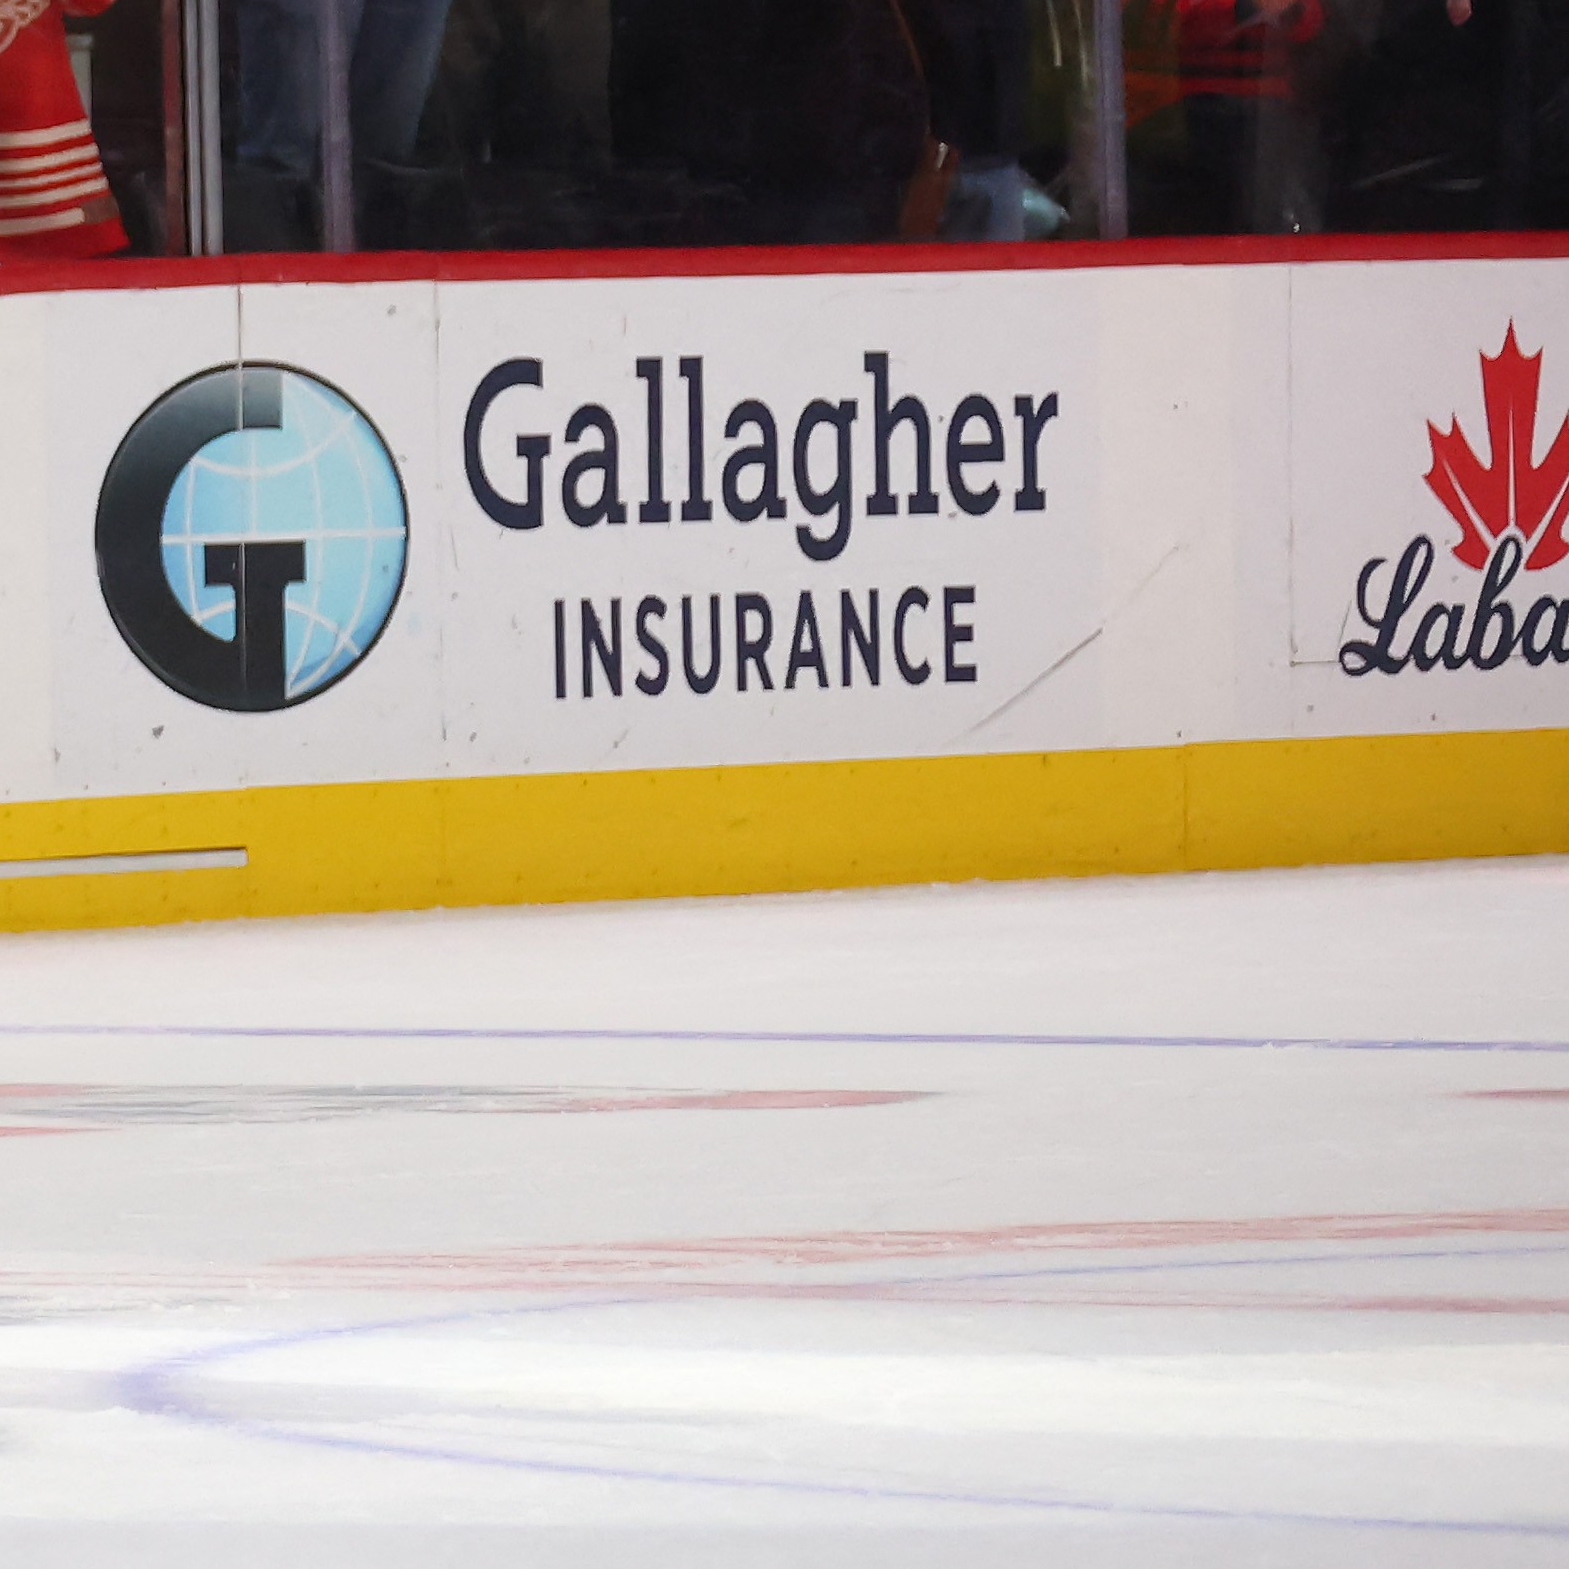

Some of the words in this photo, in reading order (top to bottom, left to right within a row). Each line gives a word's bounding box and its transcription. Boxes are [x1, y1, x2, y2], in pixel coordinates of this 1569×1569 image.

[463, 349, 1060, 562] Gallagher
[553, 586, 978, 700] INSURANCE
[1339, 534, 1569, 677] Laba
